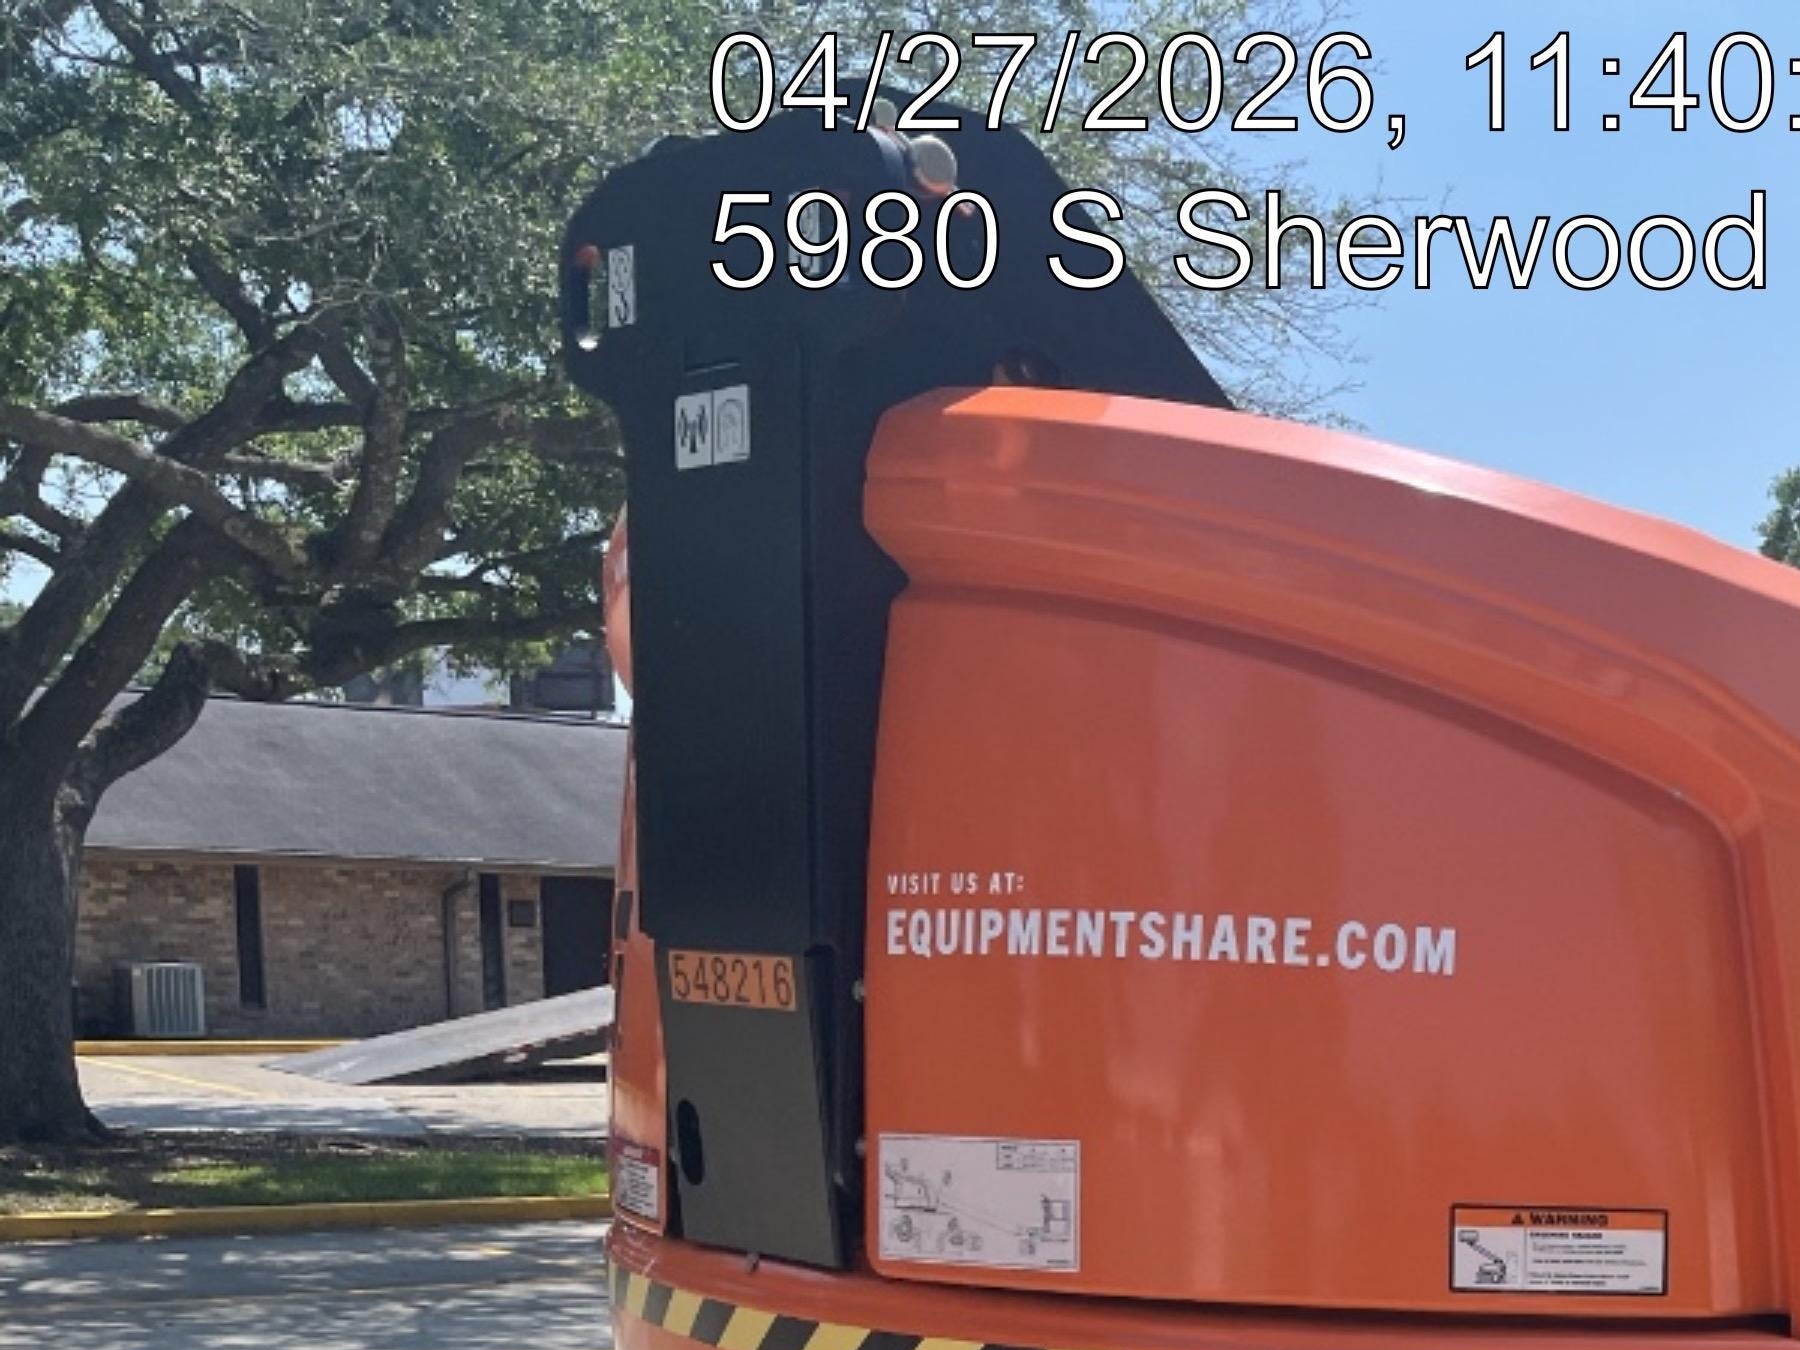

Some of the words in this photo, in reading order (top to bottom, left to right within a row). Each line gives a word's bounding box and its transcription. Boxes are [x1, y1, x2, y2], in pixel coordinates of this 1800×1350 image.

[887, 872, 940, 895] VISIT
[950, 871, 978, 895] US
[989, 872, 1025, 895] AT:
[887, 908, 1457, 976] EQUIPMENTSHARE.COM
[671, 954, 793, 1007] 548216
